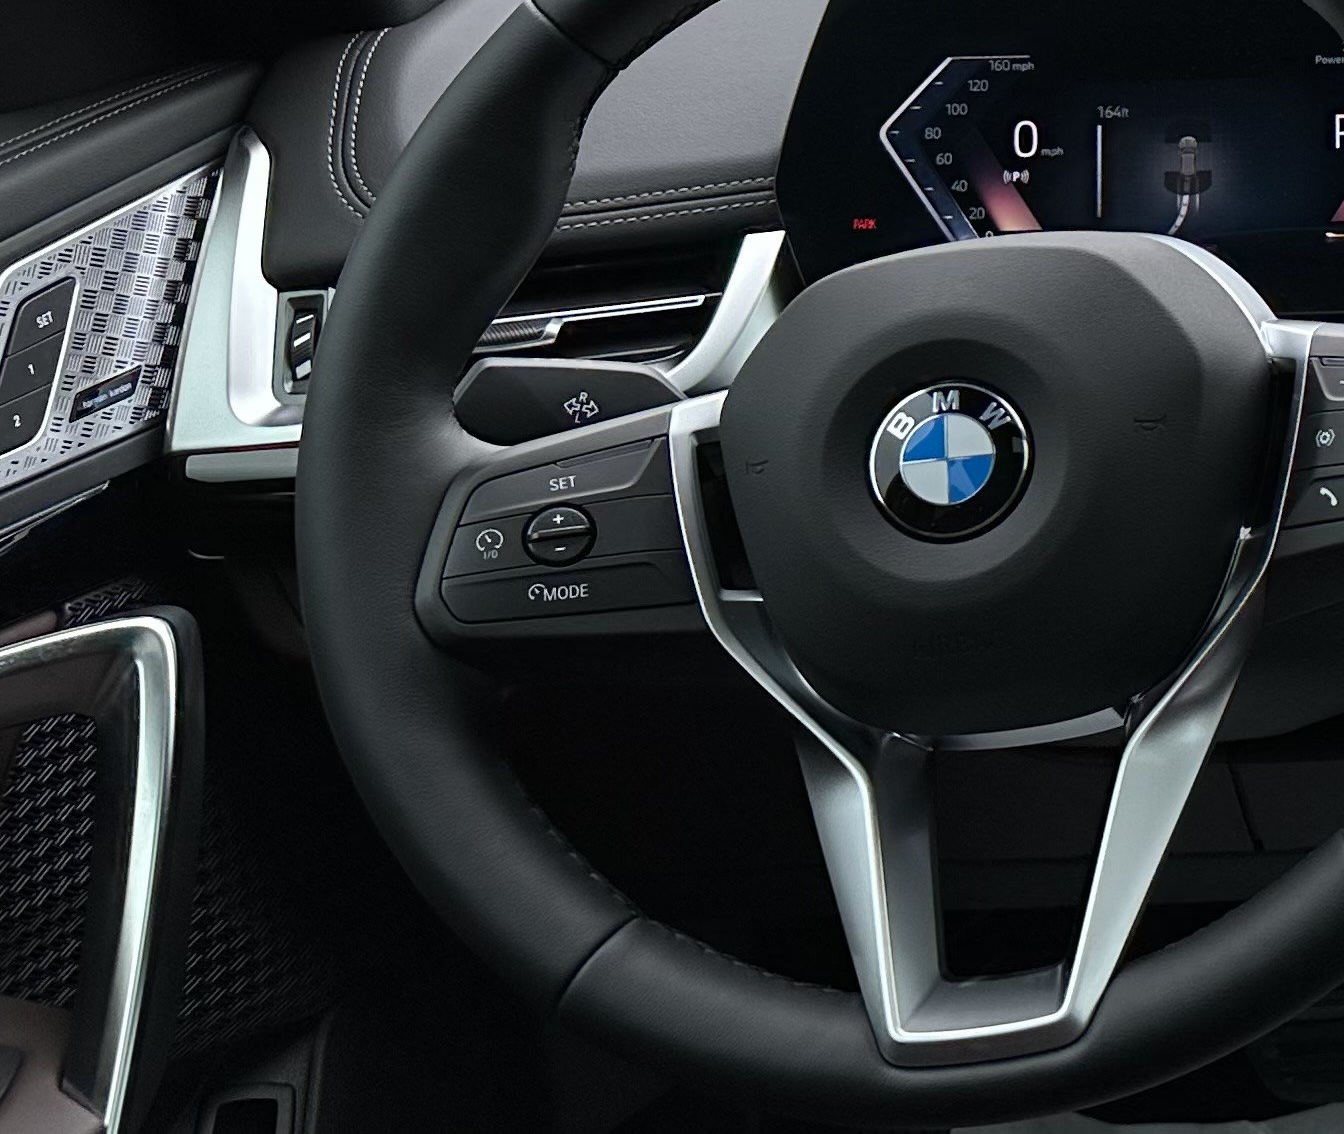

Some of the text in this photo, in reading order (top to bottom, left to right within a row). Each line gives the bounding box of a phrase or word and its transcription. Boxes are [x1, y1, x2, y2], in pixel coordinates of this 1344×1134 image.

[989, 59, 1034, 73] 160 mph
[967, 79, 989, 92] 120
[945, 103, 968, 116] 100
[924, 126, 942, 140] 80
[1013, 119, 1065, 159] 0 mph
[935, 152, 953, 166] 60
[951, 179, 968, 192] 40
[968, 206, 985, 219] 20
[851, 218, 877, 230] PARK
[888, 389, 1010, 441] BMW
[549, 475, 577, 493] SET
[543, 582, 589, 602] MODE
